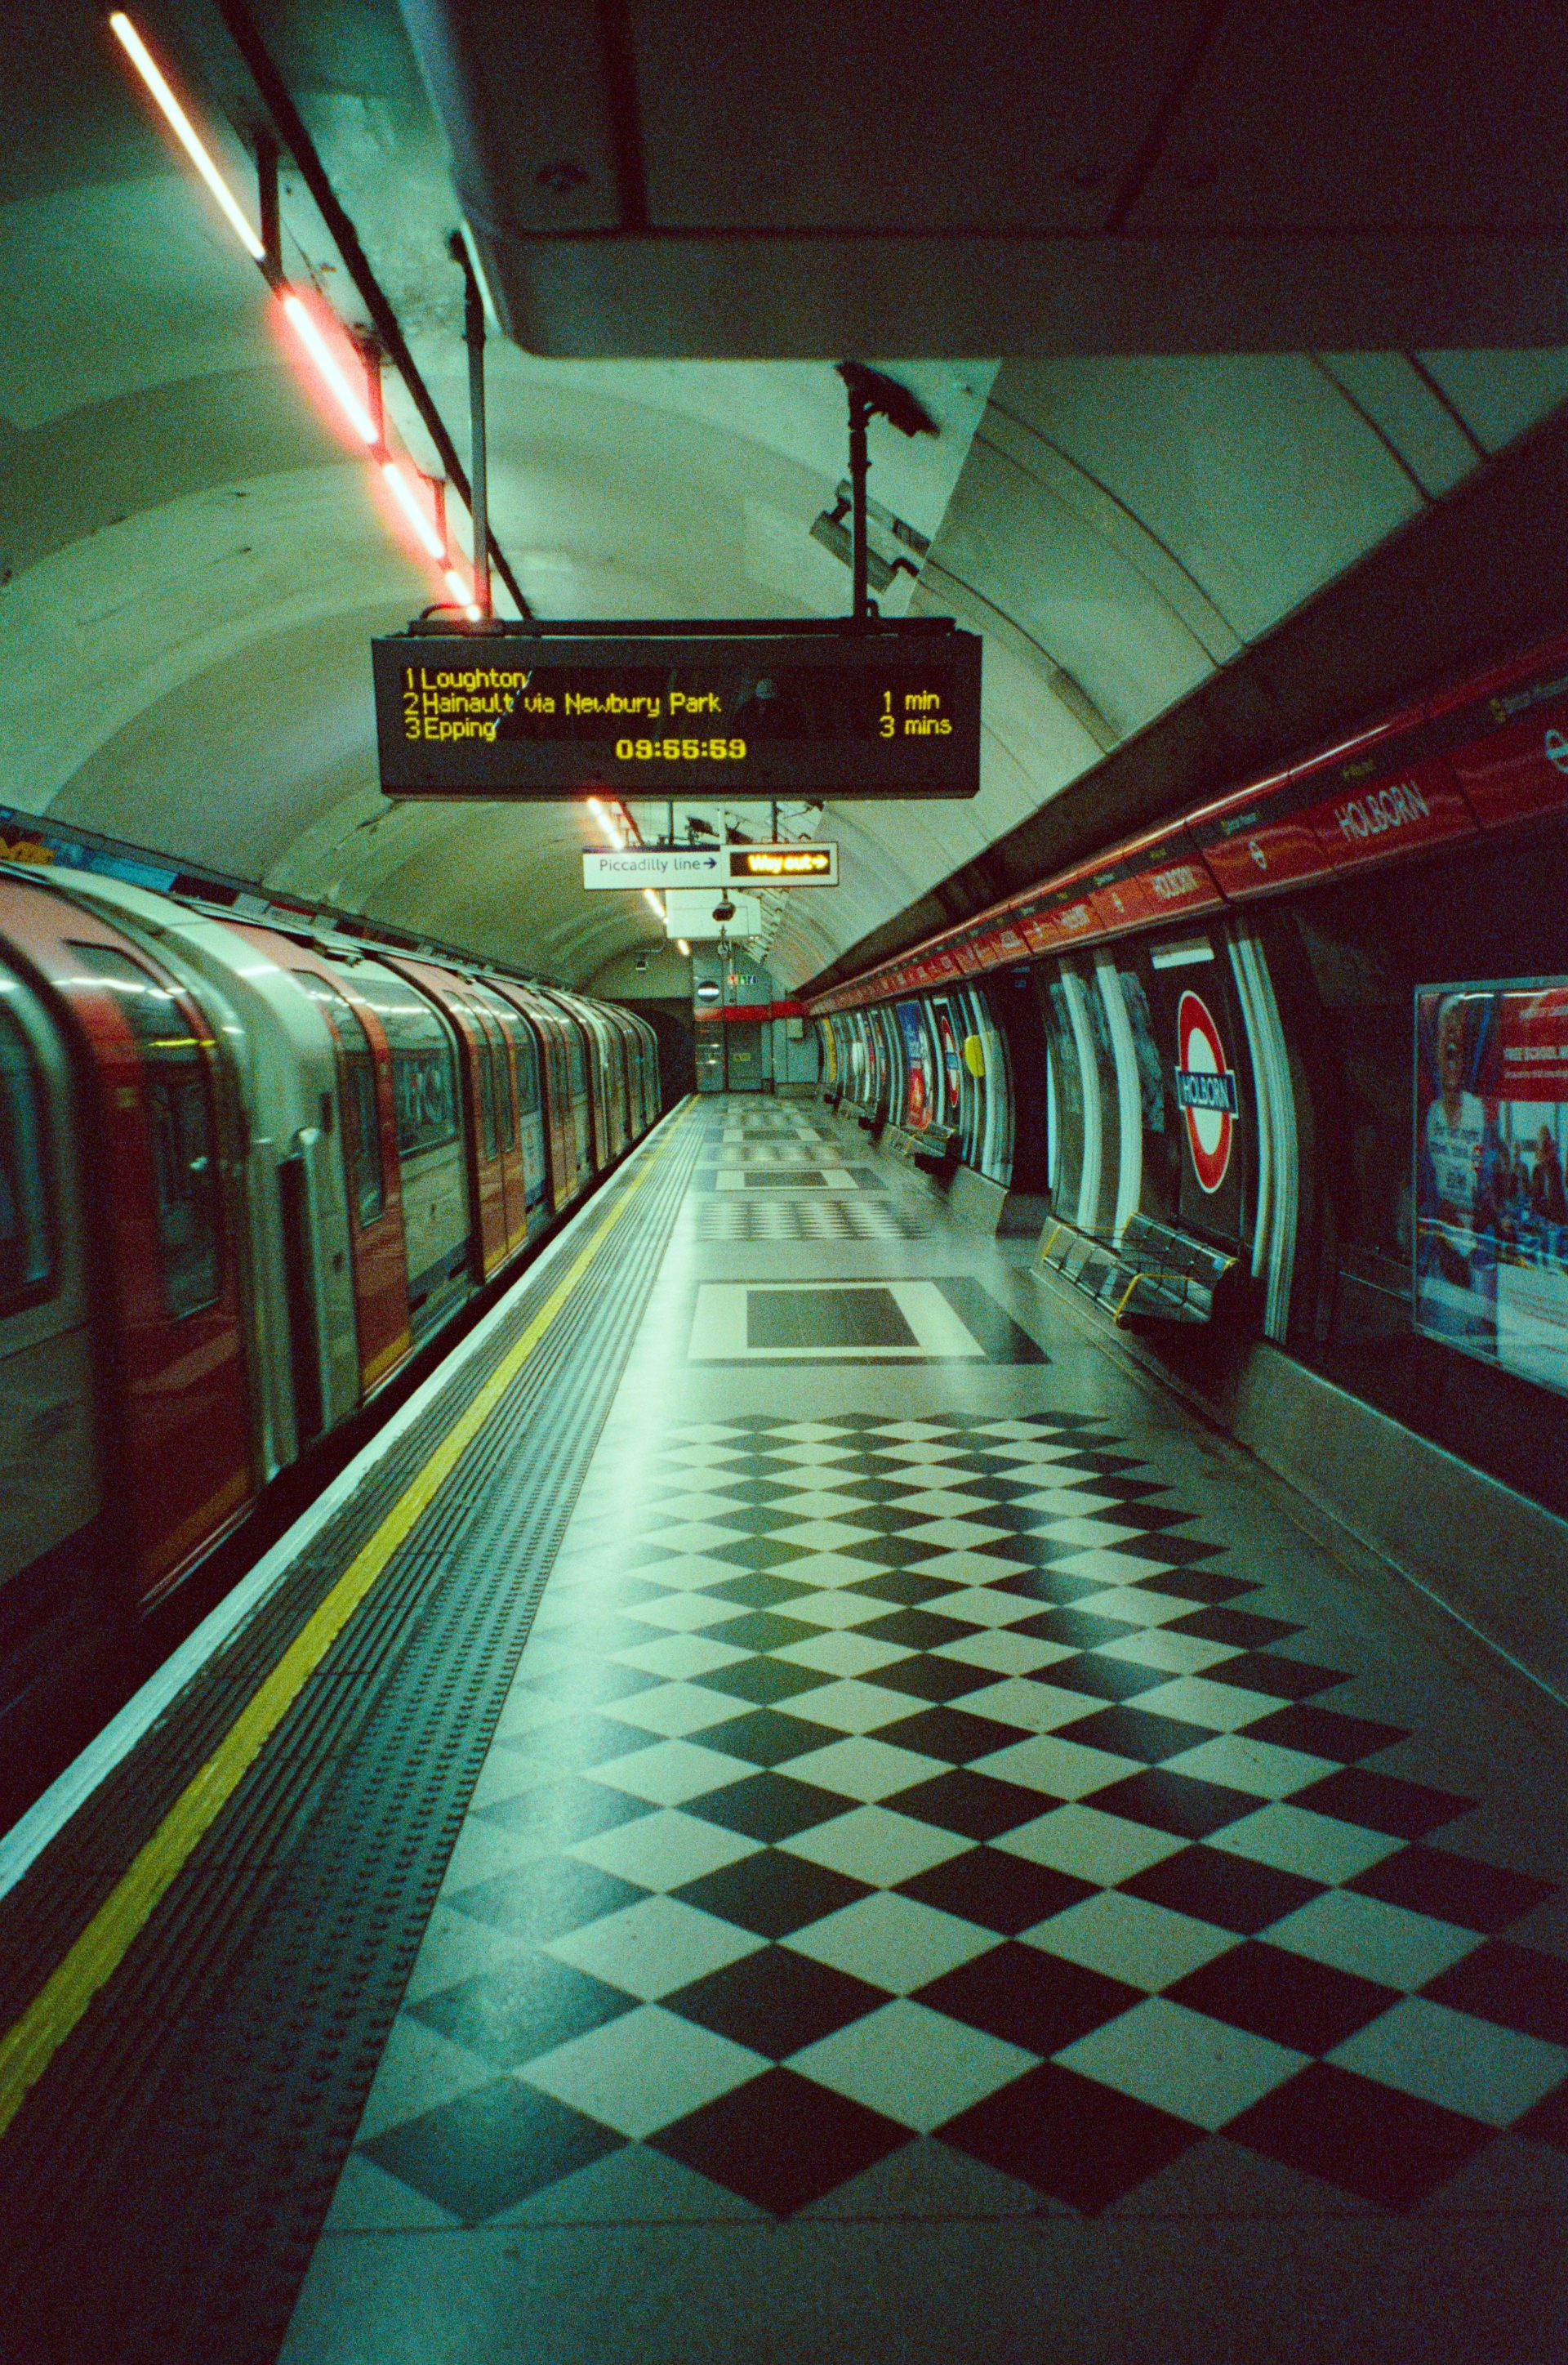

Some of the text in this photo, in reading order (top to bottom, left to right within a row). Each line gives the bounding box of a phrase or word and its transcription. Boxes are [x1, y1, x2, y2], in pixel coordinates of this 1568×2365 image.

[407, 667, 528, 692] 1 Loughton
[403, 690, 940, 717] 2 Hainault via Newbury Park 1 min
[405, 716, 952, 742] 3 Epping 3 mins
[616, 739, 746, 760] 09:55:59
[1334, 779, 1429, 842] HOLBORN
[599, 856, 701, 873] Piccadilly line
[748, 854, 813, 874] Way out
[1178, 1073, 1230, 1109] HOLBORN
